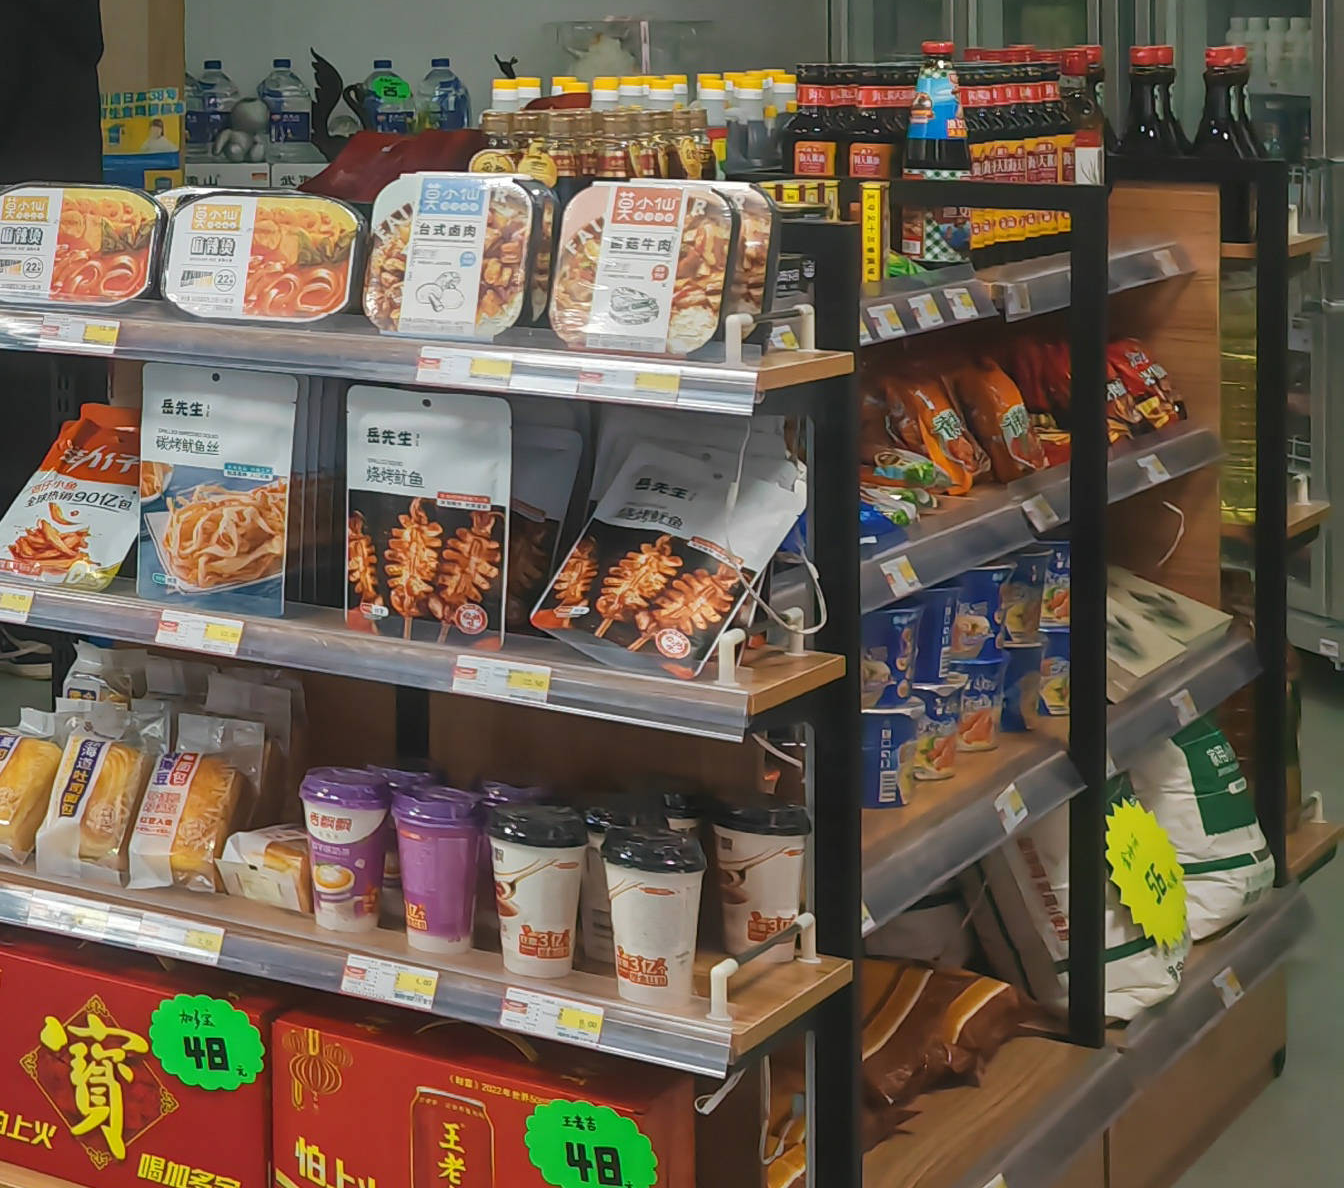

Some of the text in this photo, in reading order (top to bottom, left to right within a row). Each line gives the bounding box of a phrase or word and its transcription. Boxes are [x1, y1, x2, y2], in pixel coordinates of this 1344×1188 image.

[419, 223, 477, 238] 台式卤肉
[161, 398, 204, 418] 岳先生
[155, 434, 221, 456] 碳烤鱿鱼丝
[366, 426, 412, 447] 岳先生
[366, 465, 425, 489] 烧烤鱿鱼
[183, 1035, 229, 1071] 48
[438, 1122, 467, 1188] 王老
[565, 1141, 624, 1187] 48
